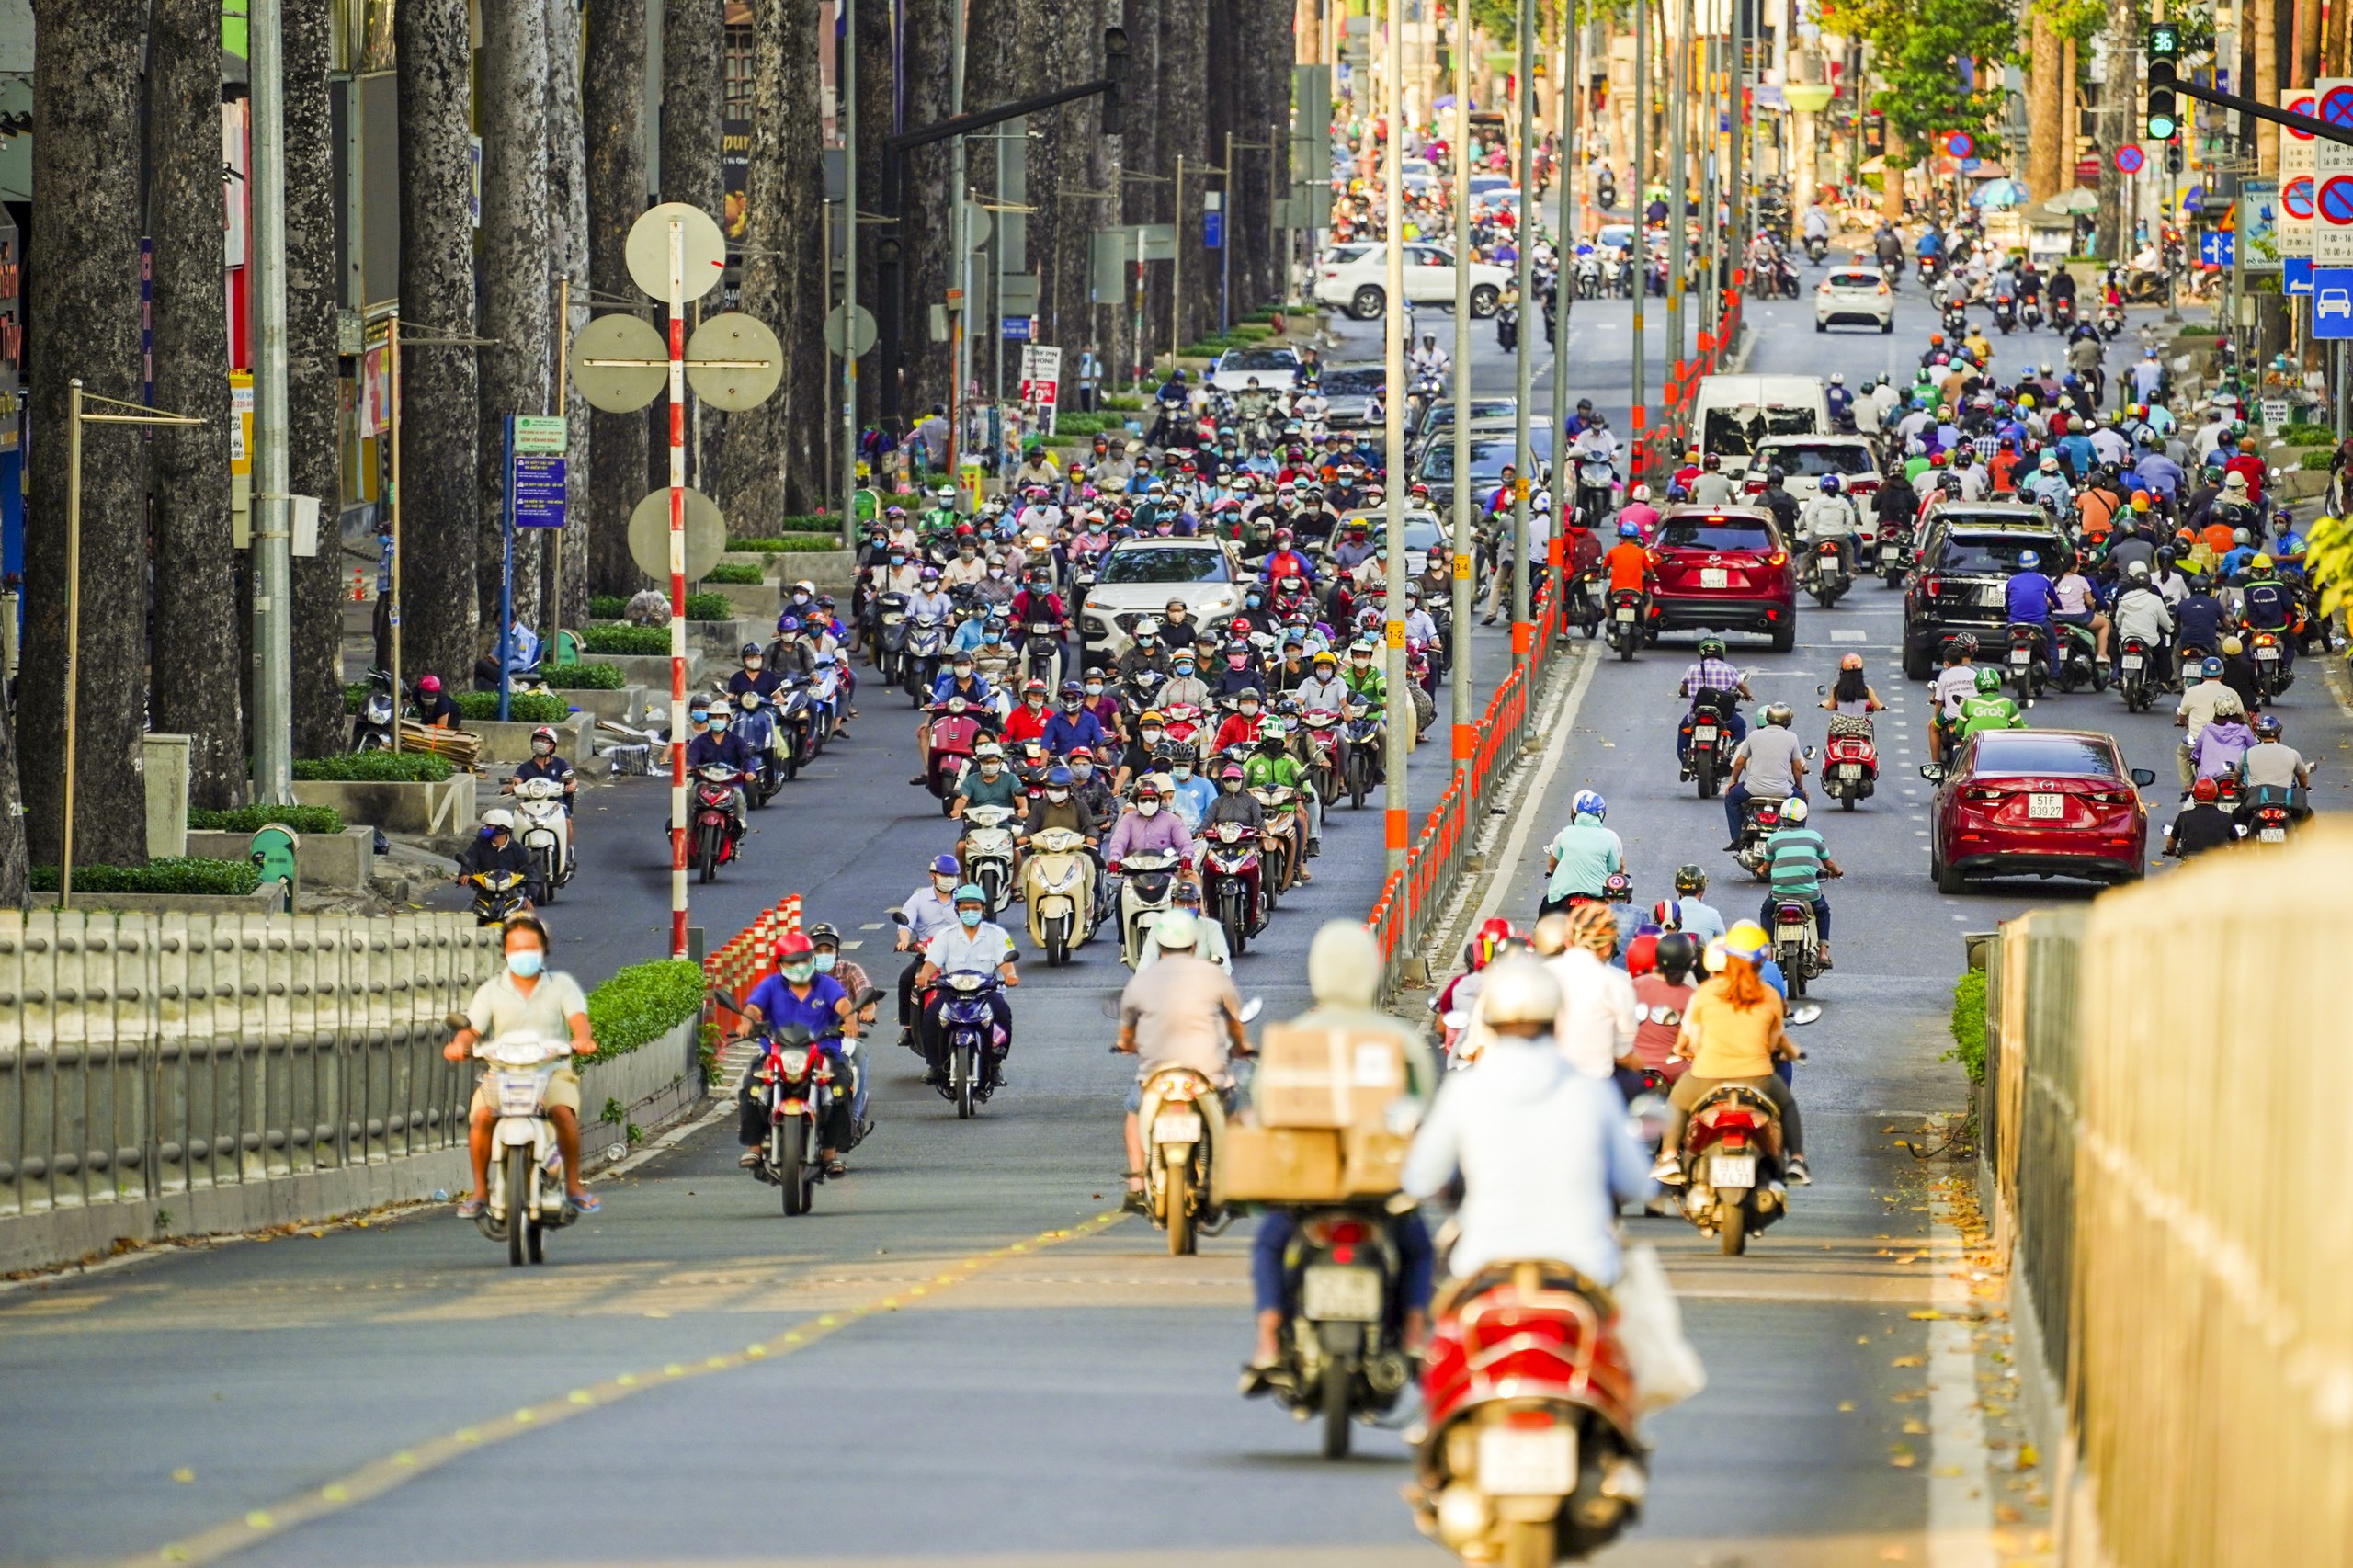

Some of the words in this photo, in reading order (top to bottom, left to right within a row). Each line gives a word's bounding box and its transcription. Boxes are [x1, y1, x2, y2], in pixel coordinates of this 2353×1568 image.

[2154, 32, 2172, 51] 36
[2324, 234, 2337, 243] 9:00
[2324, 247, 2340, 256] 20:00
[1045, 349, 1057, 358] PIN
[1389, 631, 1403, 640] 1-2
[1981, 677, 1995, 686] Grab
[1973, 706, 2006, 718] Grab
[2037, 796, 2054, 805] 51F
